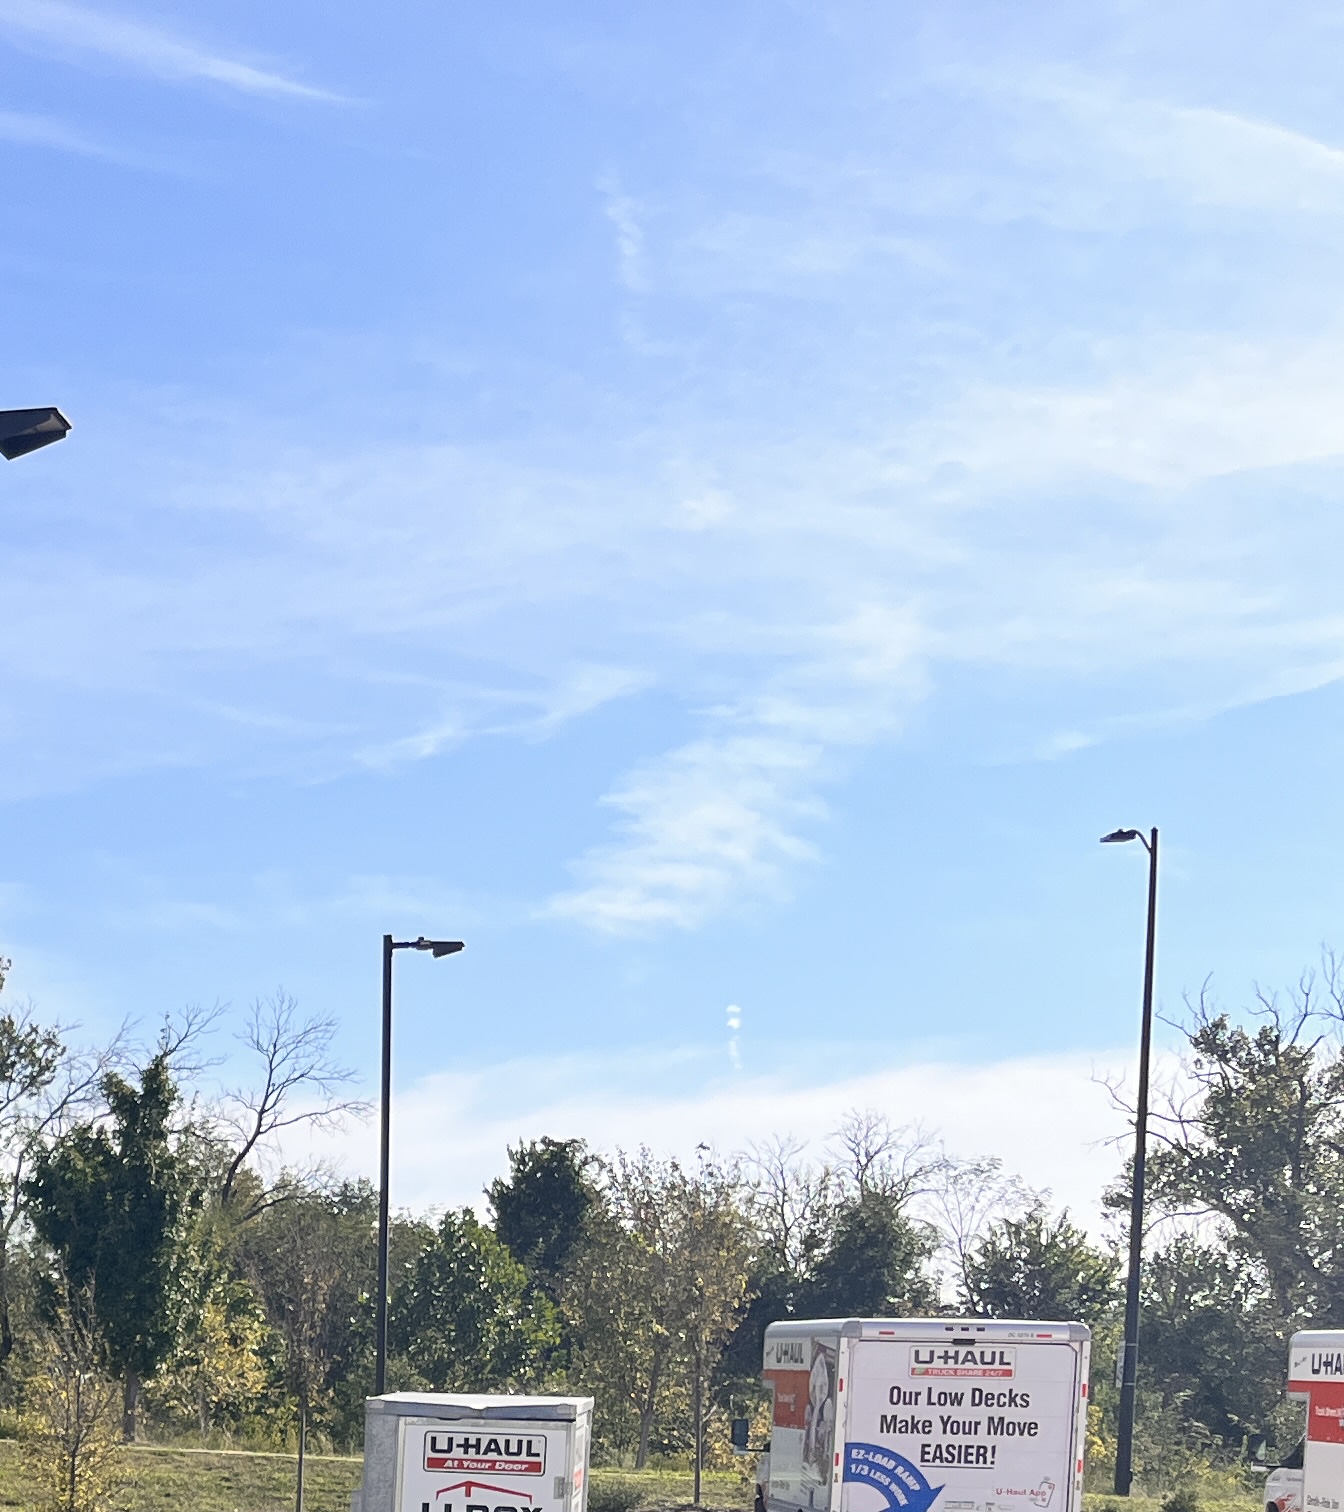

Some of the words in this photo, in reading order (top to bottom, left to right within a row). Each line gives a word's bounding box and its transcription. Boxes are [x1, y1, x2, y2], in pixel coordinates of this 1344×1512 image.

[775, 1342, 805, 1365] U-HAUL
[914, 1349, 1012, 1366] U-HAUL
[1311, 1352, 1344, 1376] U-HA
[888, 1385, 922, 1407] Our
[926, 1386, 965, 1408] Low
[970, 1388, 1031, 1409] Decks
[879, 1414, 933, 1436] Make
[939, 1415, 982, 1437] Your
[987, 1416, 1039, 1437] Move
[429, 1436, 541, 1458] U-HAUL
[919, 1443, 997, 1465] EASIER!
[443, 1460, 460, 1469] At
[462, 1460, 492, 1471] Your
[494, 1461, 529, 1472] Door
[850, 1448, 896, 1470] EZ-LOAD
[850, 1463, 870, 1476] 1/3
[869, 1469, 891, 1487] LESS
[996, 1487, 1027, 1496] U-Haul
[1029, 1488, 1047, 1498] App
